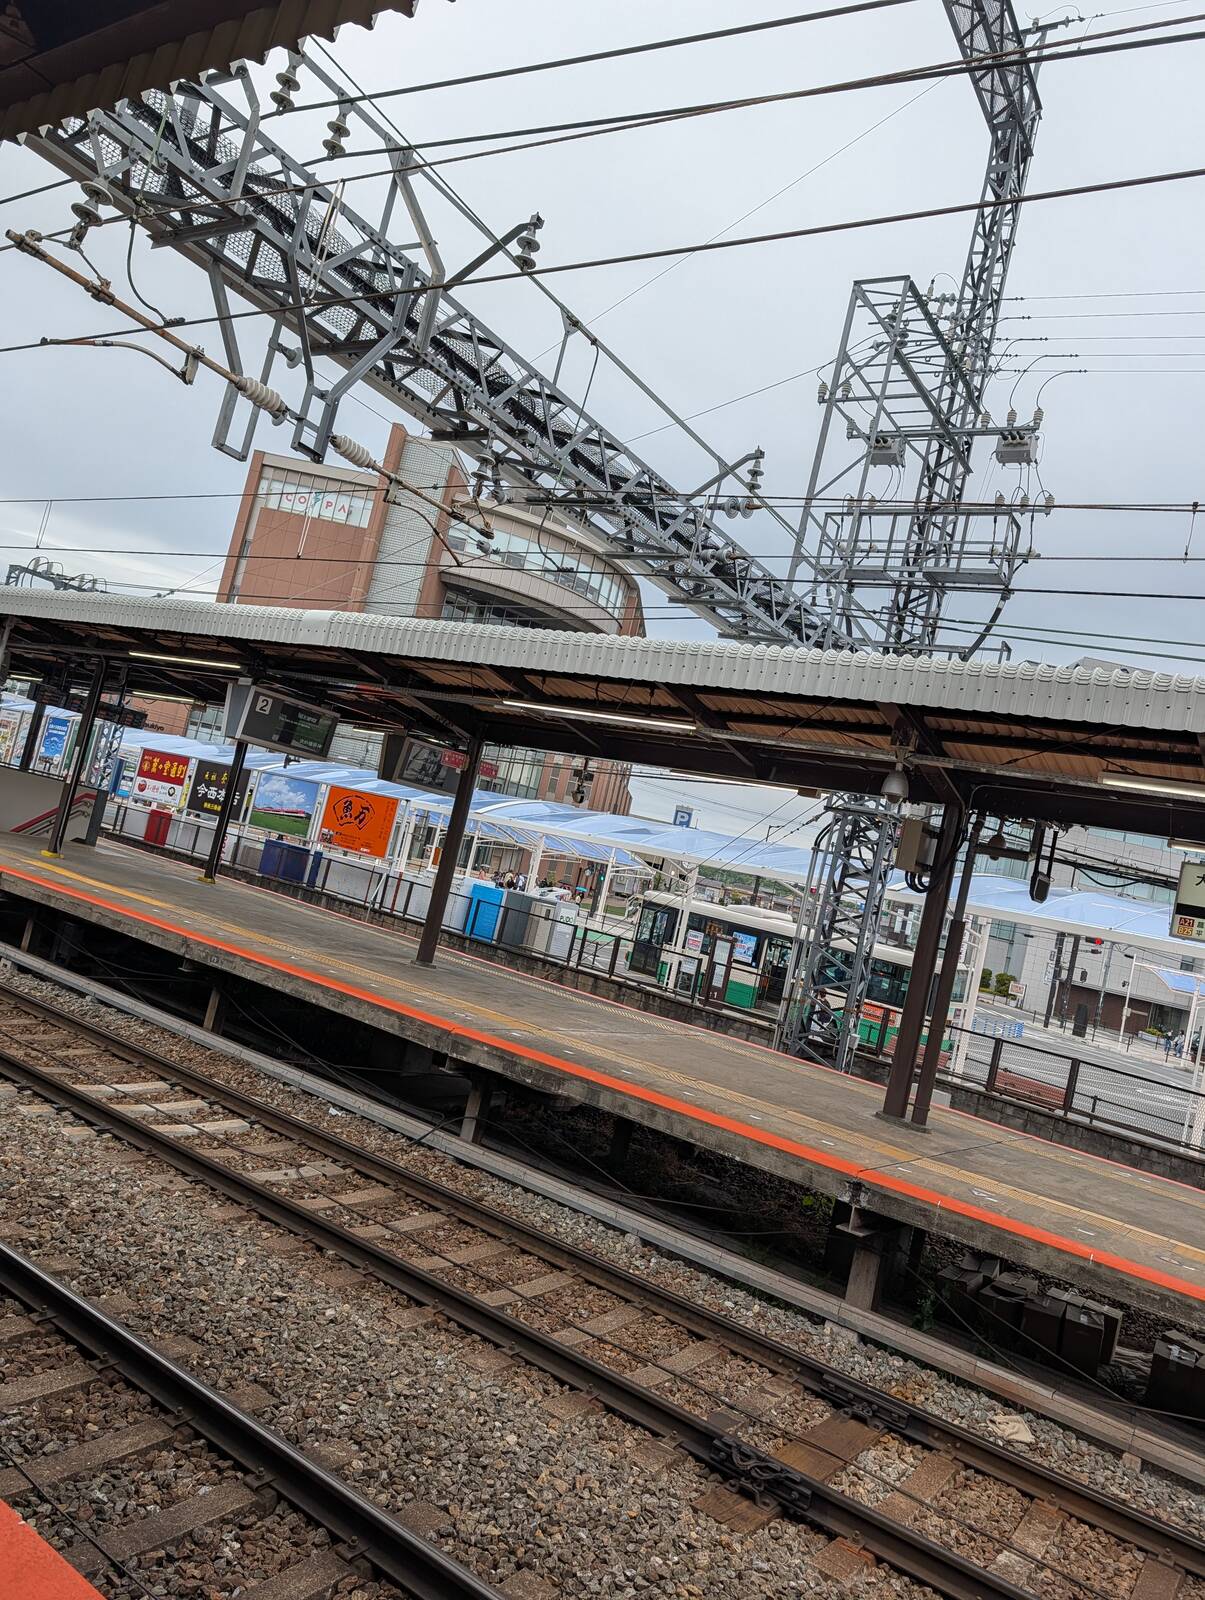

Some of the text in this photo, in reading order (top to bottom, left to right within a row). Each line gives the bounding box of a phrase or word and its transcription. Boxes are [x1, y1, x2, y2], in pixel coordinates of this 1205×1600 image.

[258, 698, 269, 713] 2
[675, 811, 690, 825] P
[1179, 918, 1193, 927] A21
[1178, 927, 1192, 936] B25
